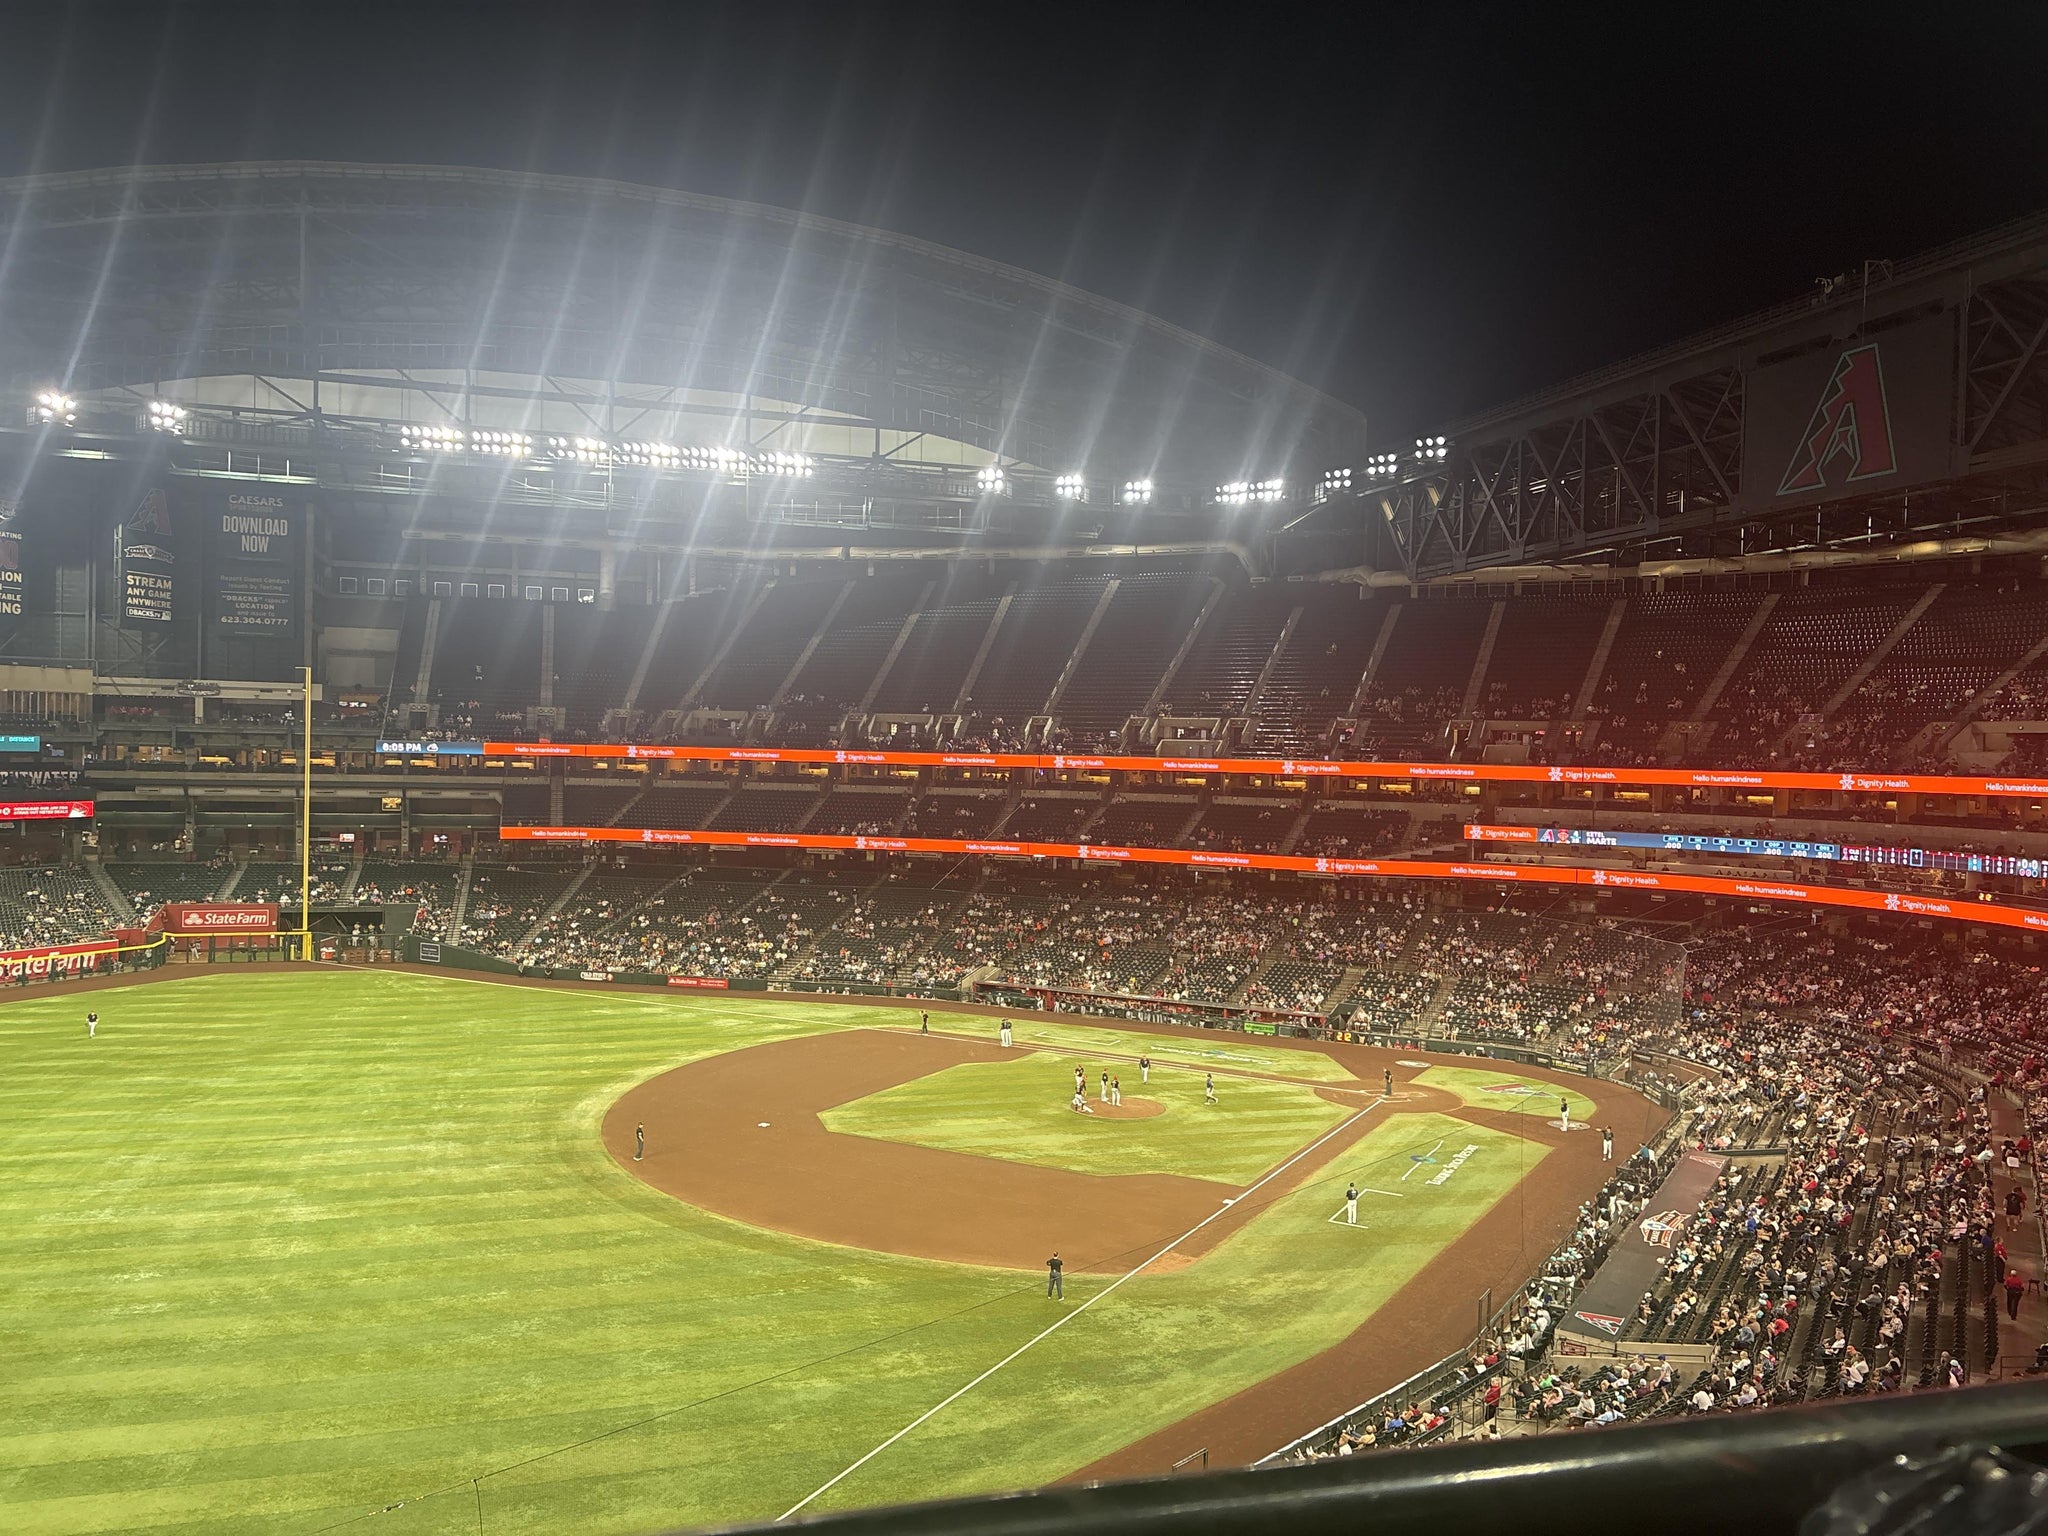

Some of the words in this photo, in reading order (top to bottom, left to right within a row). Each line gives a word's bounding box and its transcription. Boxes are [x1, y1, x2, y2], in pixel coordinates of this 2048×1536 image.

[228, 494, 283, 507] CAESARS
[223, 515, 288, 536] DOWNLOAD
[0, 531, 22, 540] ATING
[241, 534, 269, 553] NOW
[0, 570, 22, 583] ION
[127, 575, 172, 590] STREAM
[127, 587, 146, 596] ANY
[148, 589, 172, 600] GAME
[127, 597, 172, 609] ANYWHERE
[235, 602, 275, 610] LOCATION
[220, 615, 289, 626] 623.304.0777
[405, 742, 422, 752] PM
[1296, 764, 1318, 772] Dignity
[1566, 771, 1590, 780] Dignity
[1693, 774, 1709, 782] Hello
[1710, 775, 1763, 783] humankindness
[1857, 778, 1884, 788] Dignity
[1986, 782, 2004, 791] Hello
[1485, 829, 1508, 838] Dignity
[868, 840, 887, 848] Dignity
[1586, 837, 1617, 846] MARTE
[1090, 849, 1110, 857] Dignity
[1331, 862, 1355, 871] Dignity
[1450, 866, 1467, 874] Hello
[1468, 867, 1517, 877] humankindness
[1609, 876, 1634, 885] Dignity
[1736, 884, 1753, 892] Hello
[1754, 886, 1807, 897] humankindness
[1902, 899, 1926, 911] Dignity
[2024, 915, 2040, 925] Hello
